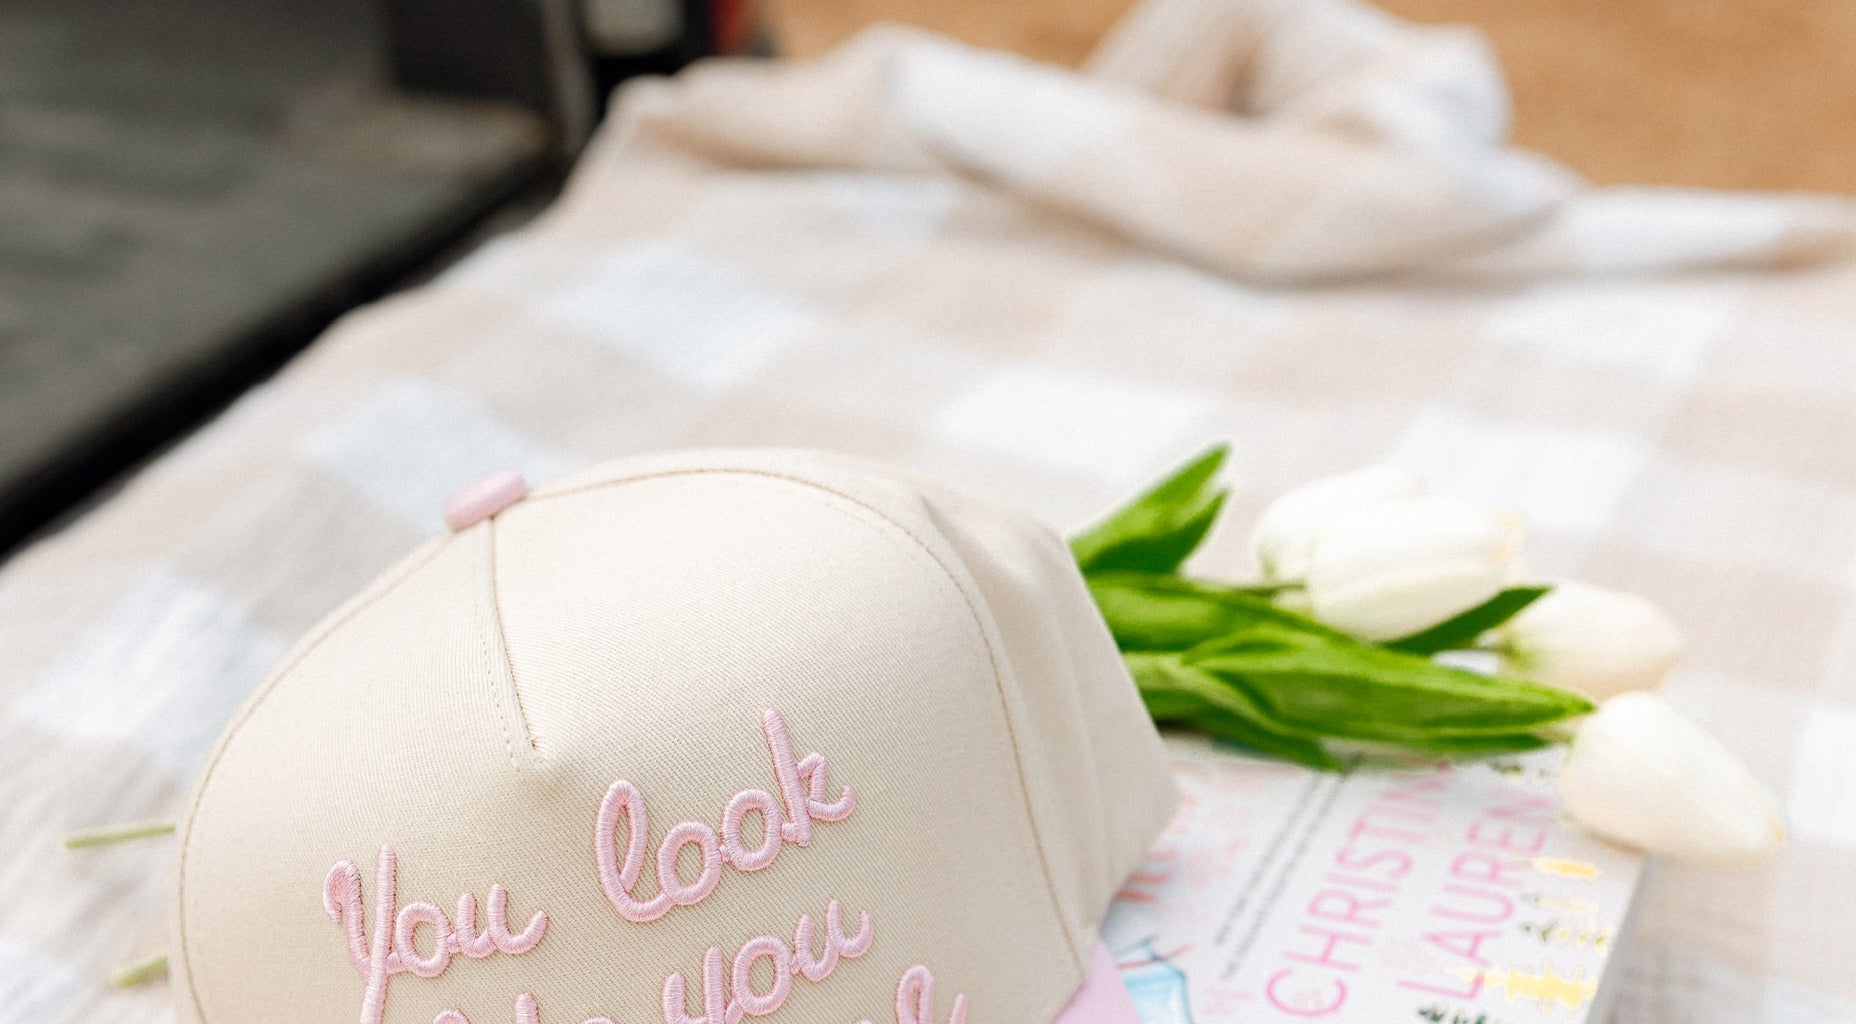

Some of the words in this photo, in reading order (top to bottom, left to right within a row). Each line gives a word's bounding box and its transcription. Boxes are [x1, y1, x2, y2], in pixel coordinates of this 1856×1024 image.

[594, 708, 856, 923] look
[1266, 757, 1455, 1018] CHRISTIN
[1398, 785, 1562, 1002] LAUREN
